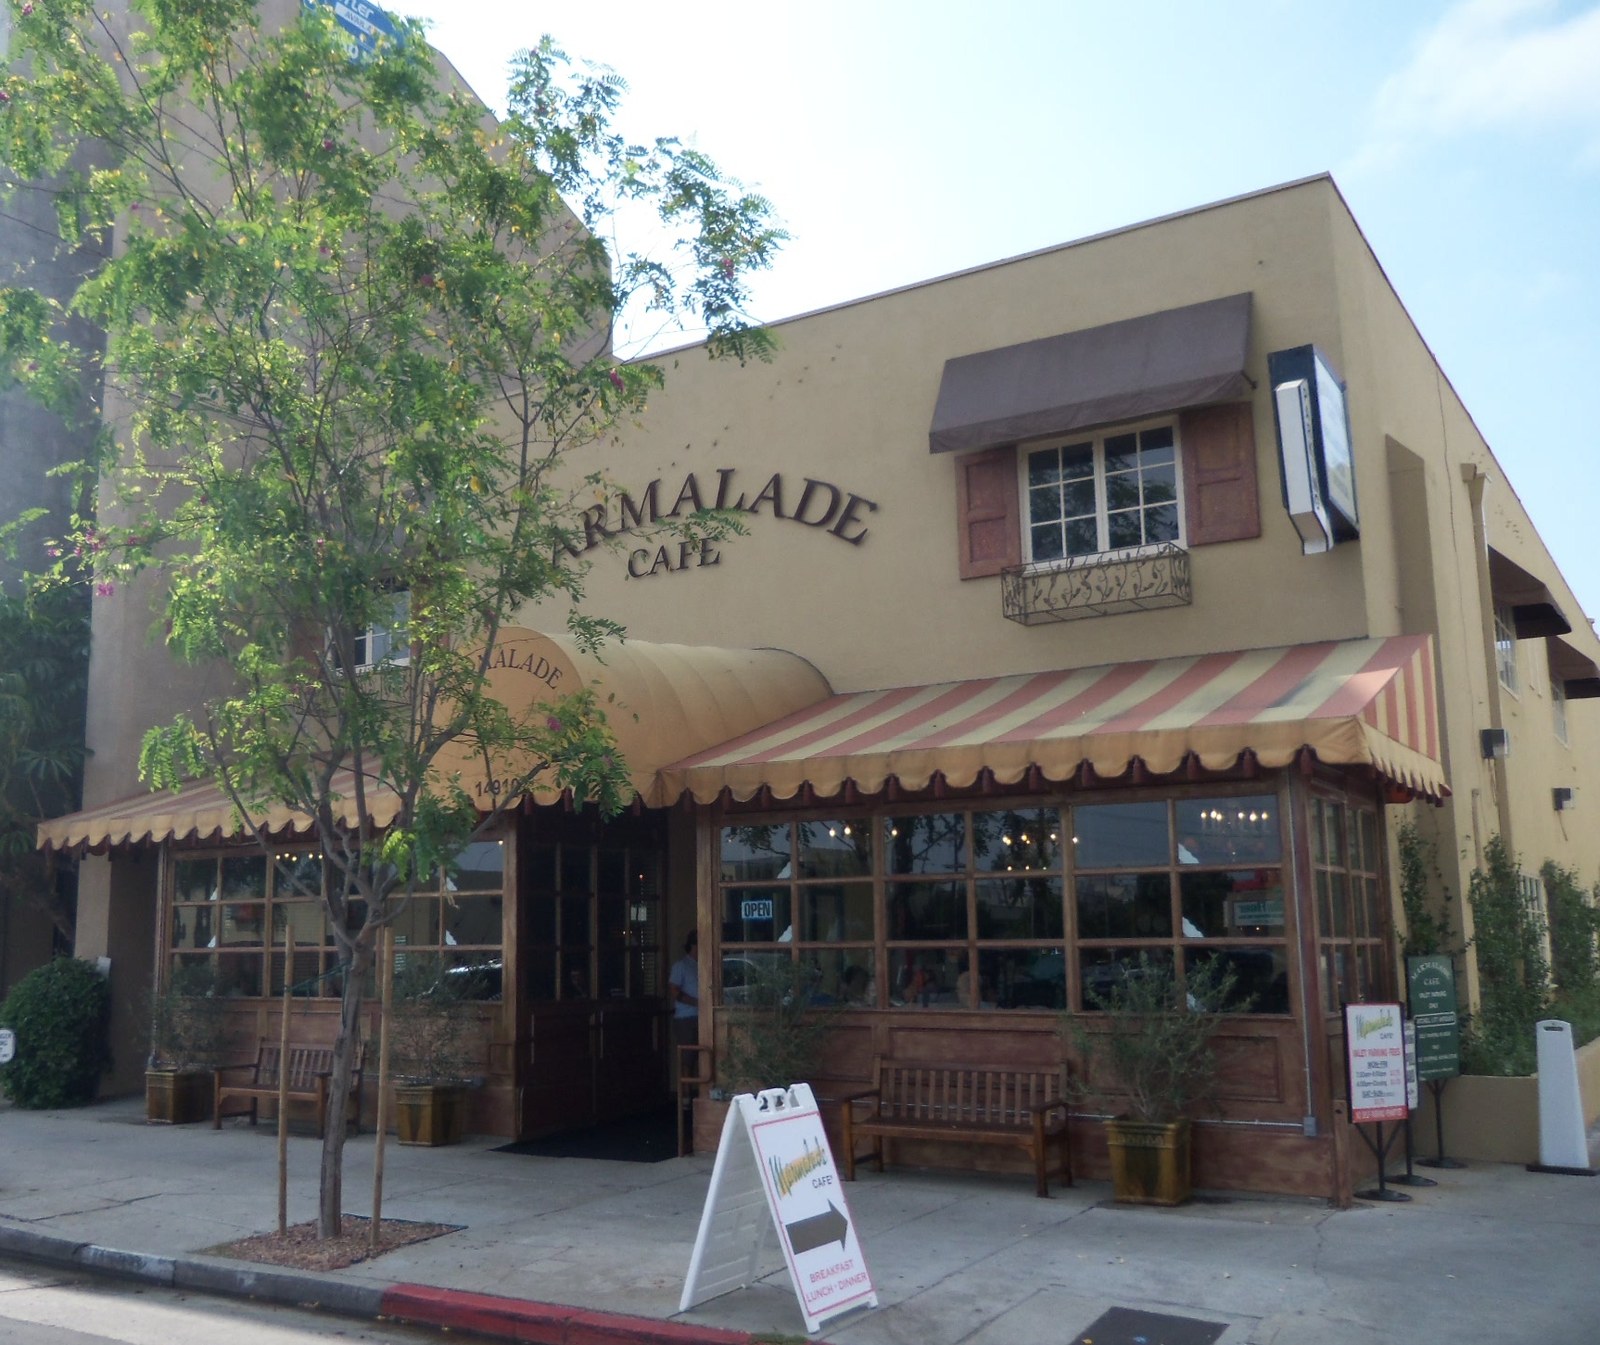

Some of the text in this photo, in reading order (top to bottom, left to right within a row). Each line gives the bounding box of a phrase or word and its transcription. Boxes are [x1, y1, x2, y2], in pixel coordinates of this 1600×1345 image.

[551, 468, 878, 569] ARMALADE
[627, 537, 721, 578] CAFE
[743, 902, 771, 917] OPEN
[809, 1259, 855, 1284] BREAKFAST
[806, 1272, 868, 1303] LUNCH DINNER
